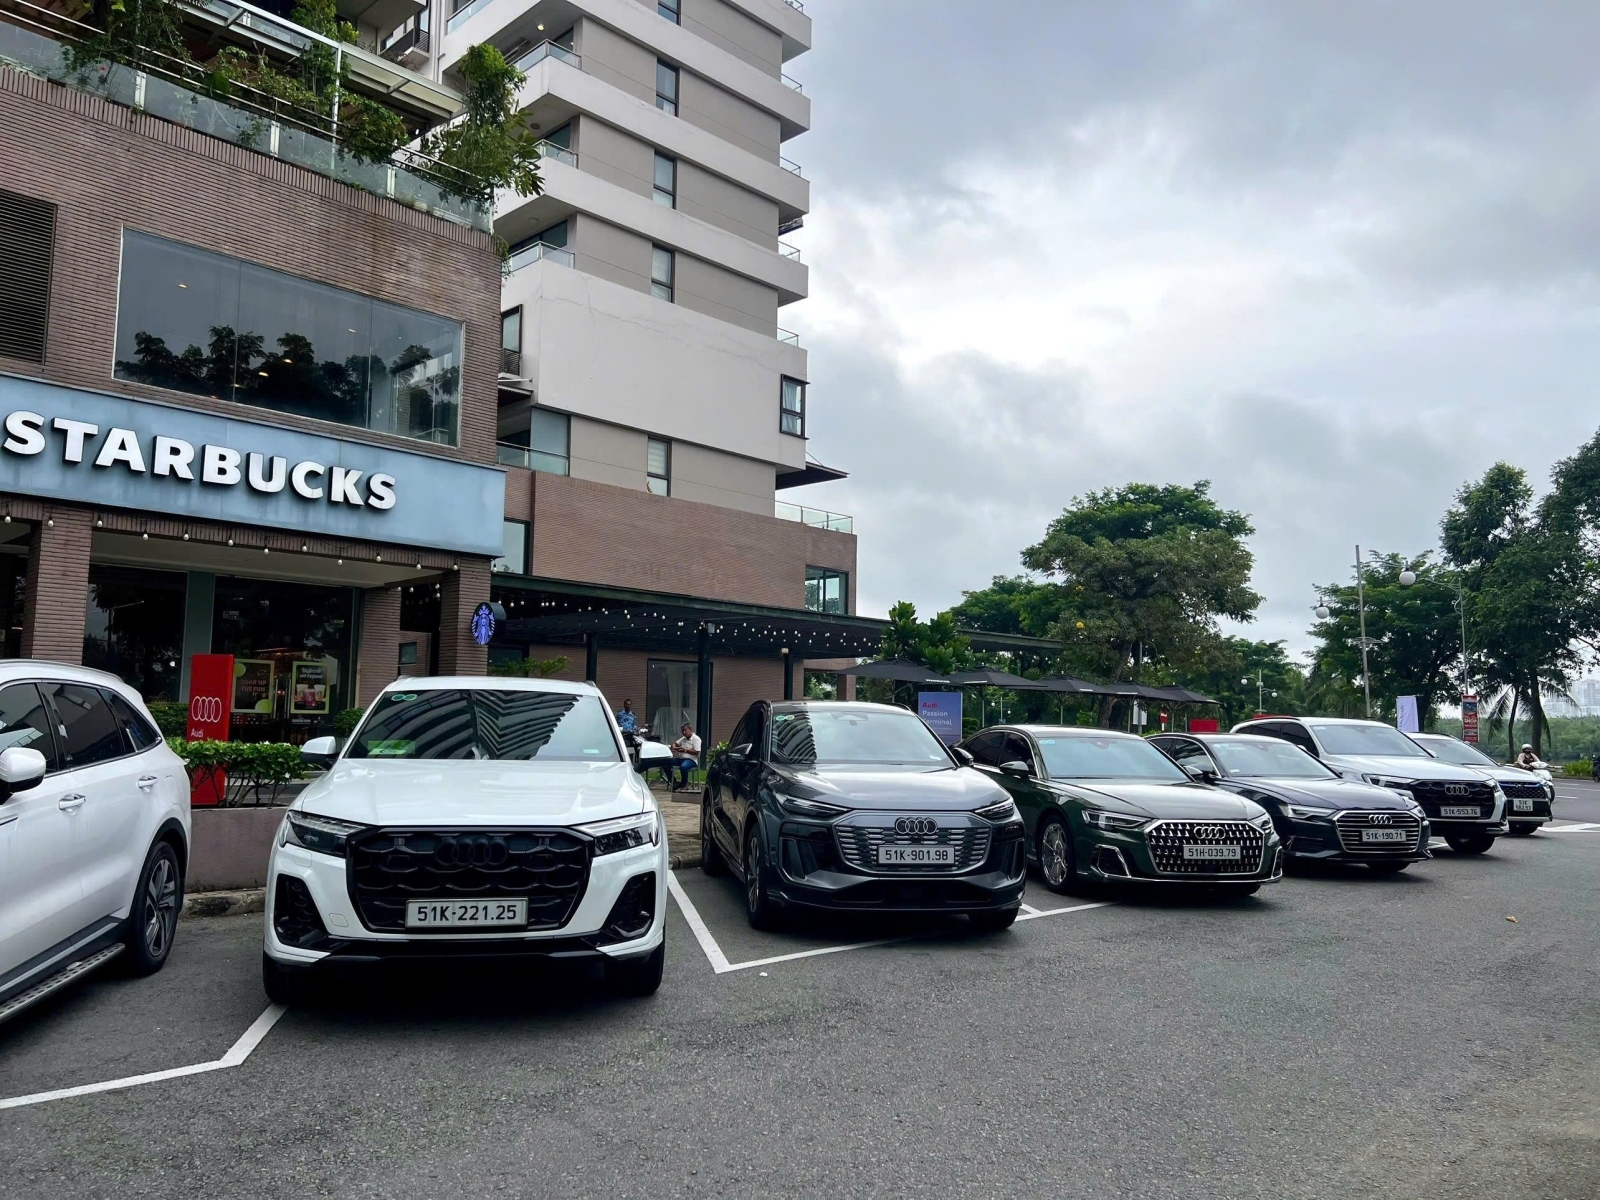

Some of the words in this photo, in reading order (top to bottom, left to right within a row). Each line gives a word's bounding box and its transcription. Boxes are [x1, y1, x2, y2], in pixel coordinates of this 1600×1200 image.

[3, 409, 397, 511] STARBUCKS
[190, 728, 204, 738] Audi
[1365, 832, 1403, 840] 51K-190.71
[885, 849, 949, 861] 51K-901.98
[1188, 848, 1237, 857] 51H-039.79
[417, 905, 517, 922] 51K-221.25
